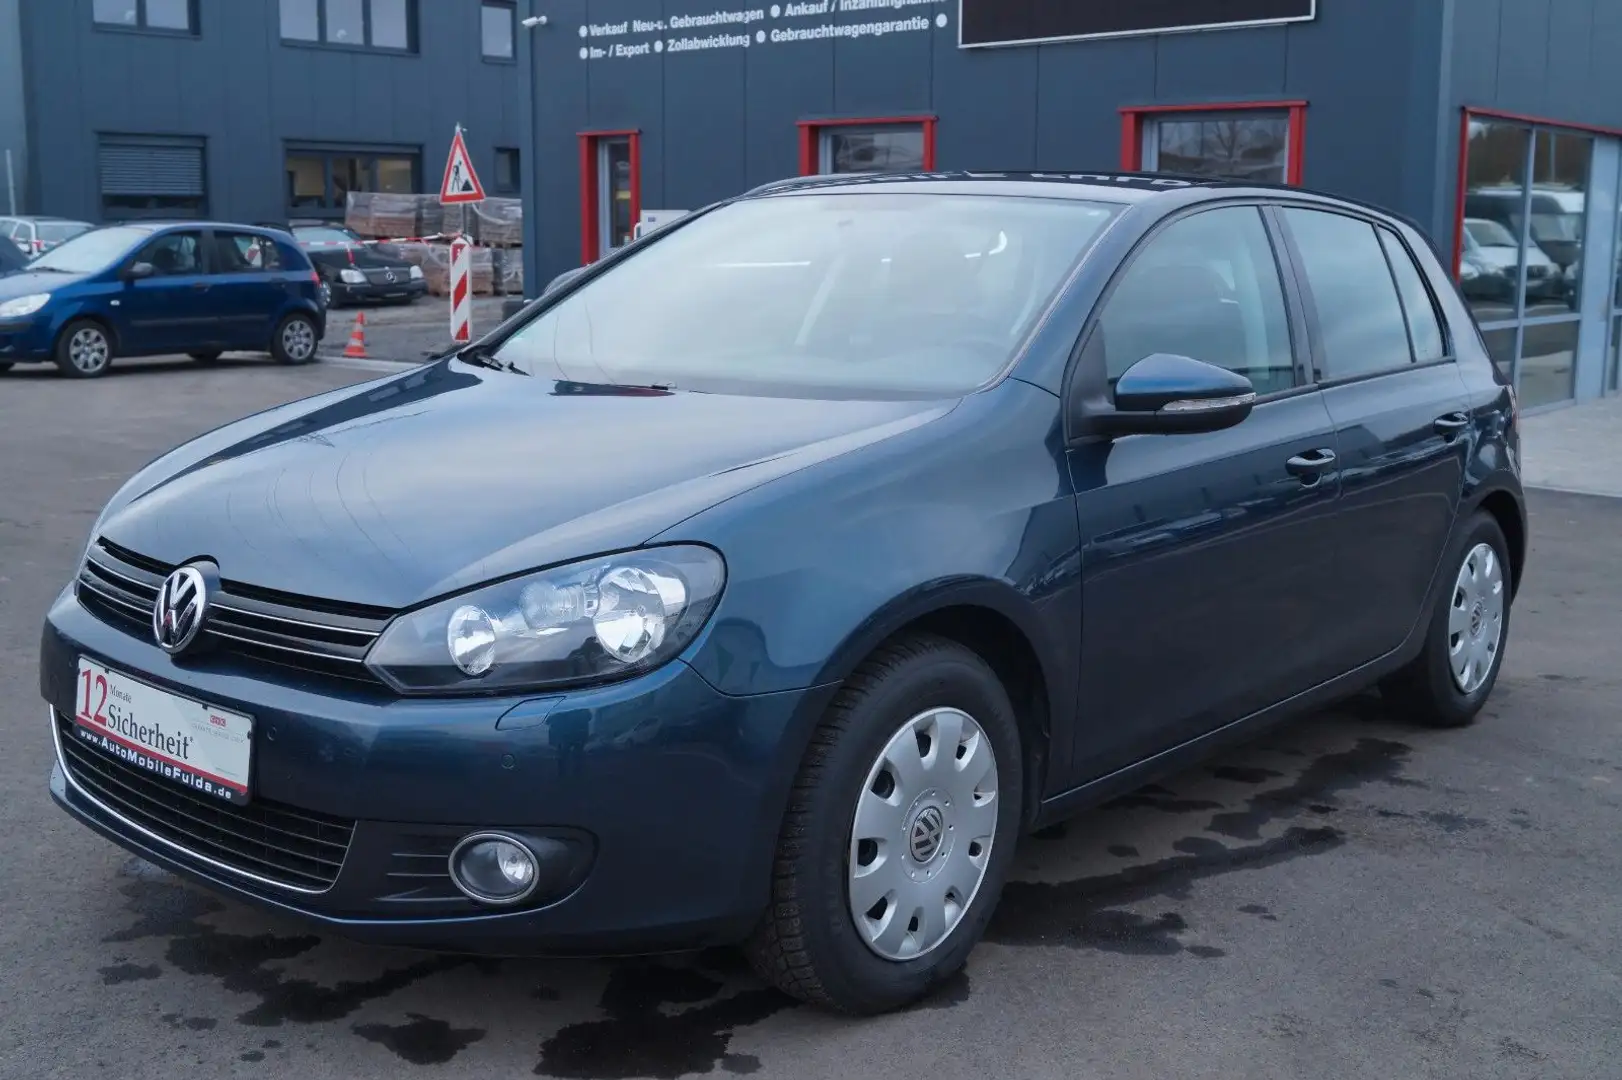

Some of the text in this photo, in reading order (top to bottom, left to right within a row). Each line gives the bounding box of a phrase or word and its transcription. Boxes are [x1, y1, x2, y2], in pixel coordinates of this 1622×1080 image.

[589, 21, 629, 36] Verkauf
[670, 8, 764, 29] Gebrauchtwagen
[784, 1, 828, 17] Ankauf
[615, 42, 650, 58] Export
[667, 33, 750, 52] Zollabwicklung
[771, 16, 929, 42] Gebrauchtwagengarantie
[81, 669, 132, 727] 12 Monate
